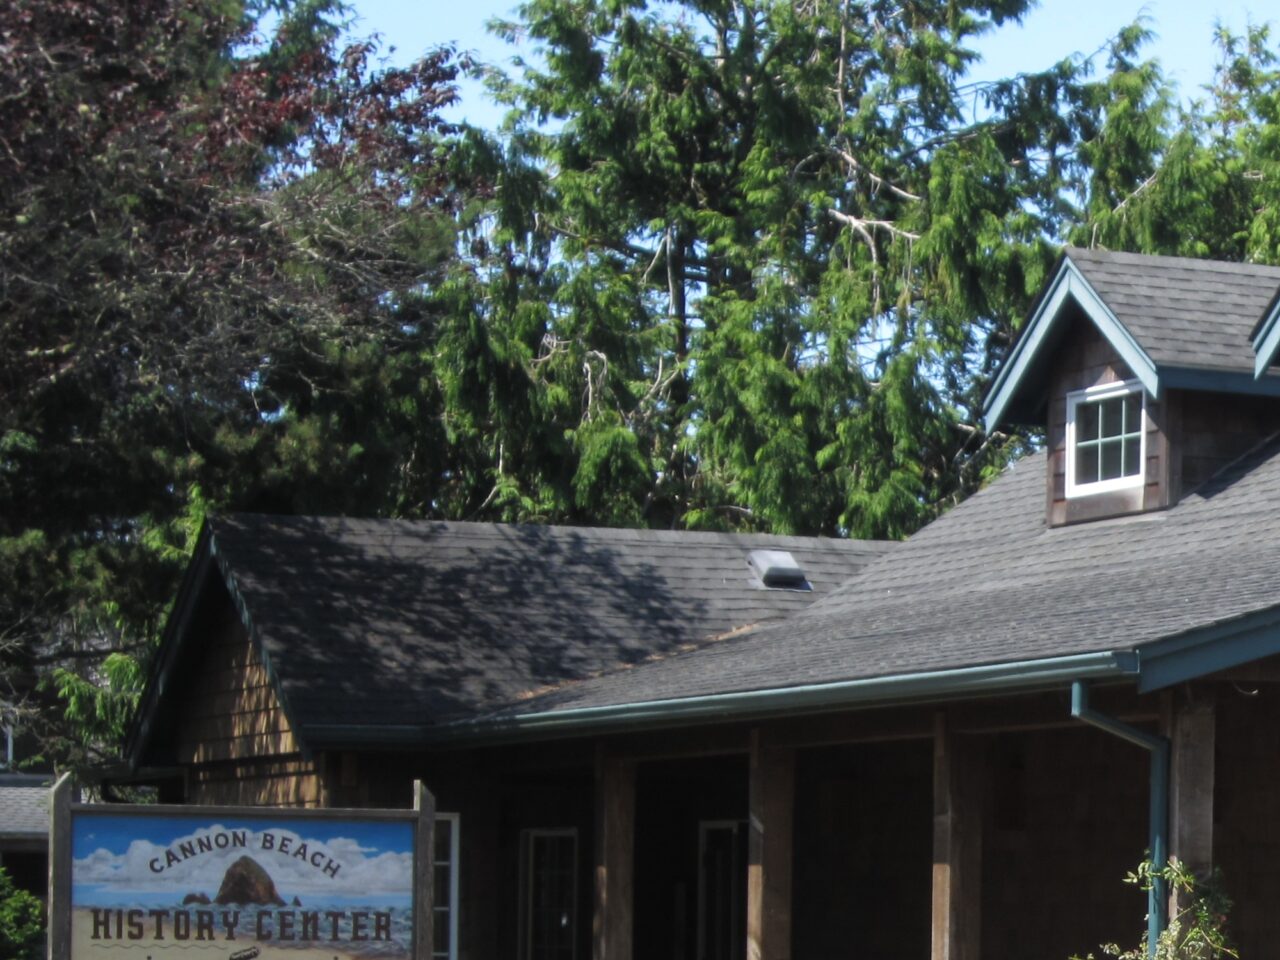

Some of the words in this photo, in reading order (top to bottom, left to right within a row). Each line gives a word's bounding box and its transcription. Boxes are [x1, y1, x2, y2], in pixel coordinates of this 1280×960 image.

[148, 830, 248, 874] CANNON
[260, 832, 342, 880] BEACH
[91, 908, 241, 942] HISTORY
[255, 911, 393, 943] CENTER
